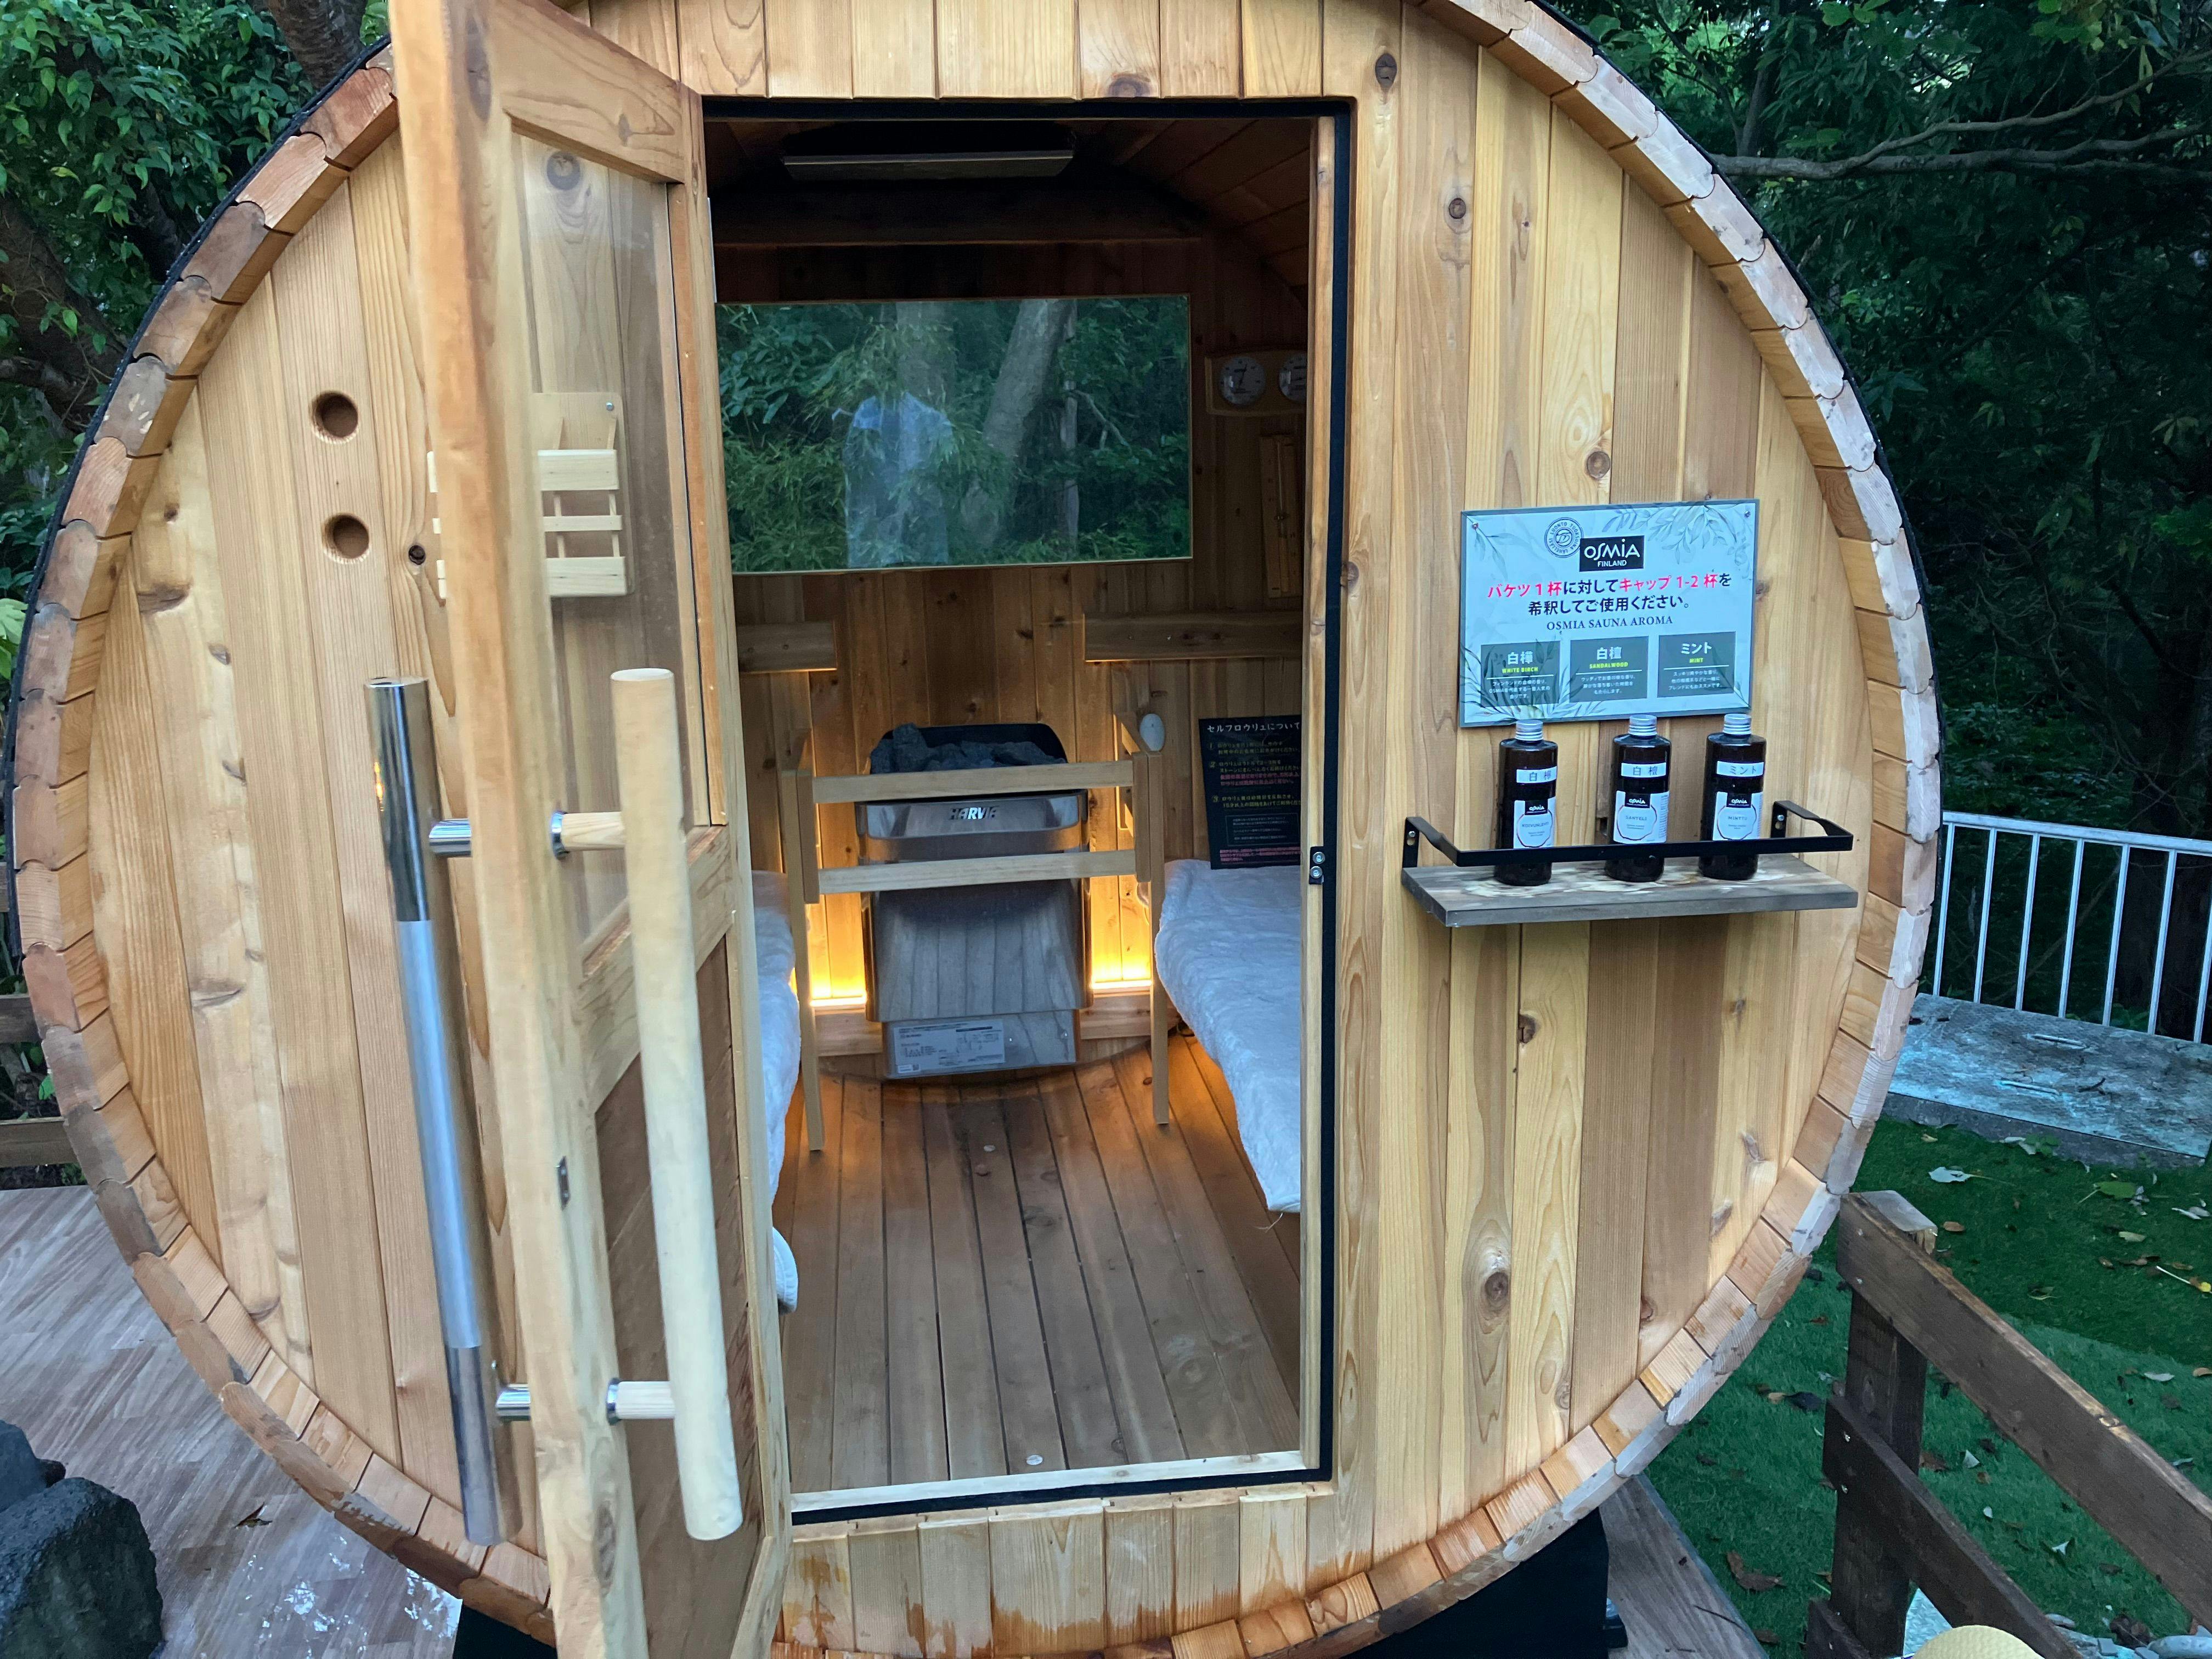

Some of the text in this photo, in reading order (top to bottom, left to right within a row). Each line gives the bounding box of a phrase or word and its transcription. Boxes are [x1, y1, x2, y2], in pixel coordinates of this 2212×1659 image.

[1528, 595, 1689, 616] 希釈してご使用ください。
[1547, 616, 1673, 630] OSMIA SAUNA AROMA
[1681, 642, 1712, 654] ミント
[1207, 722, 1300, 733] セルフロウリュについて
[1730, 766, 1756, 775] ミント
[949, 806, 998, 820] HARVIA
